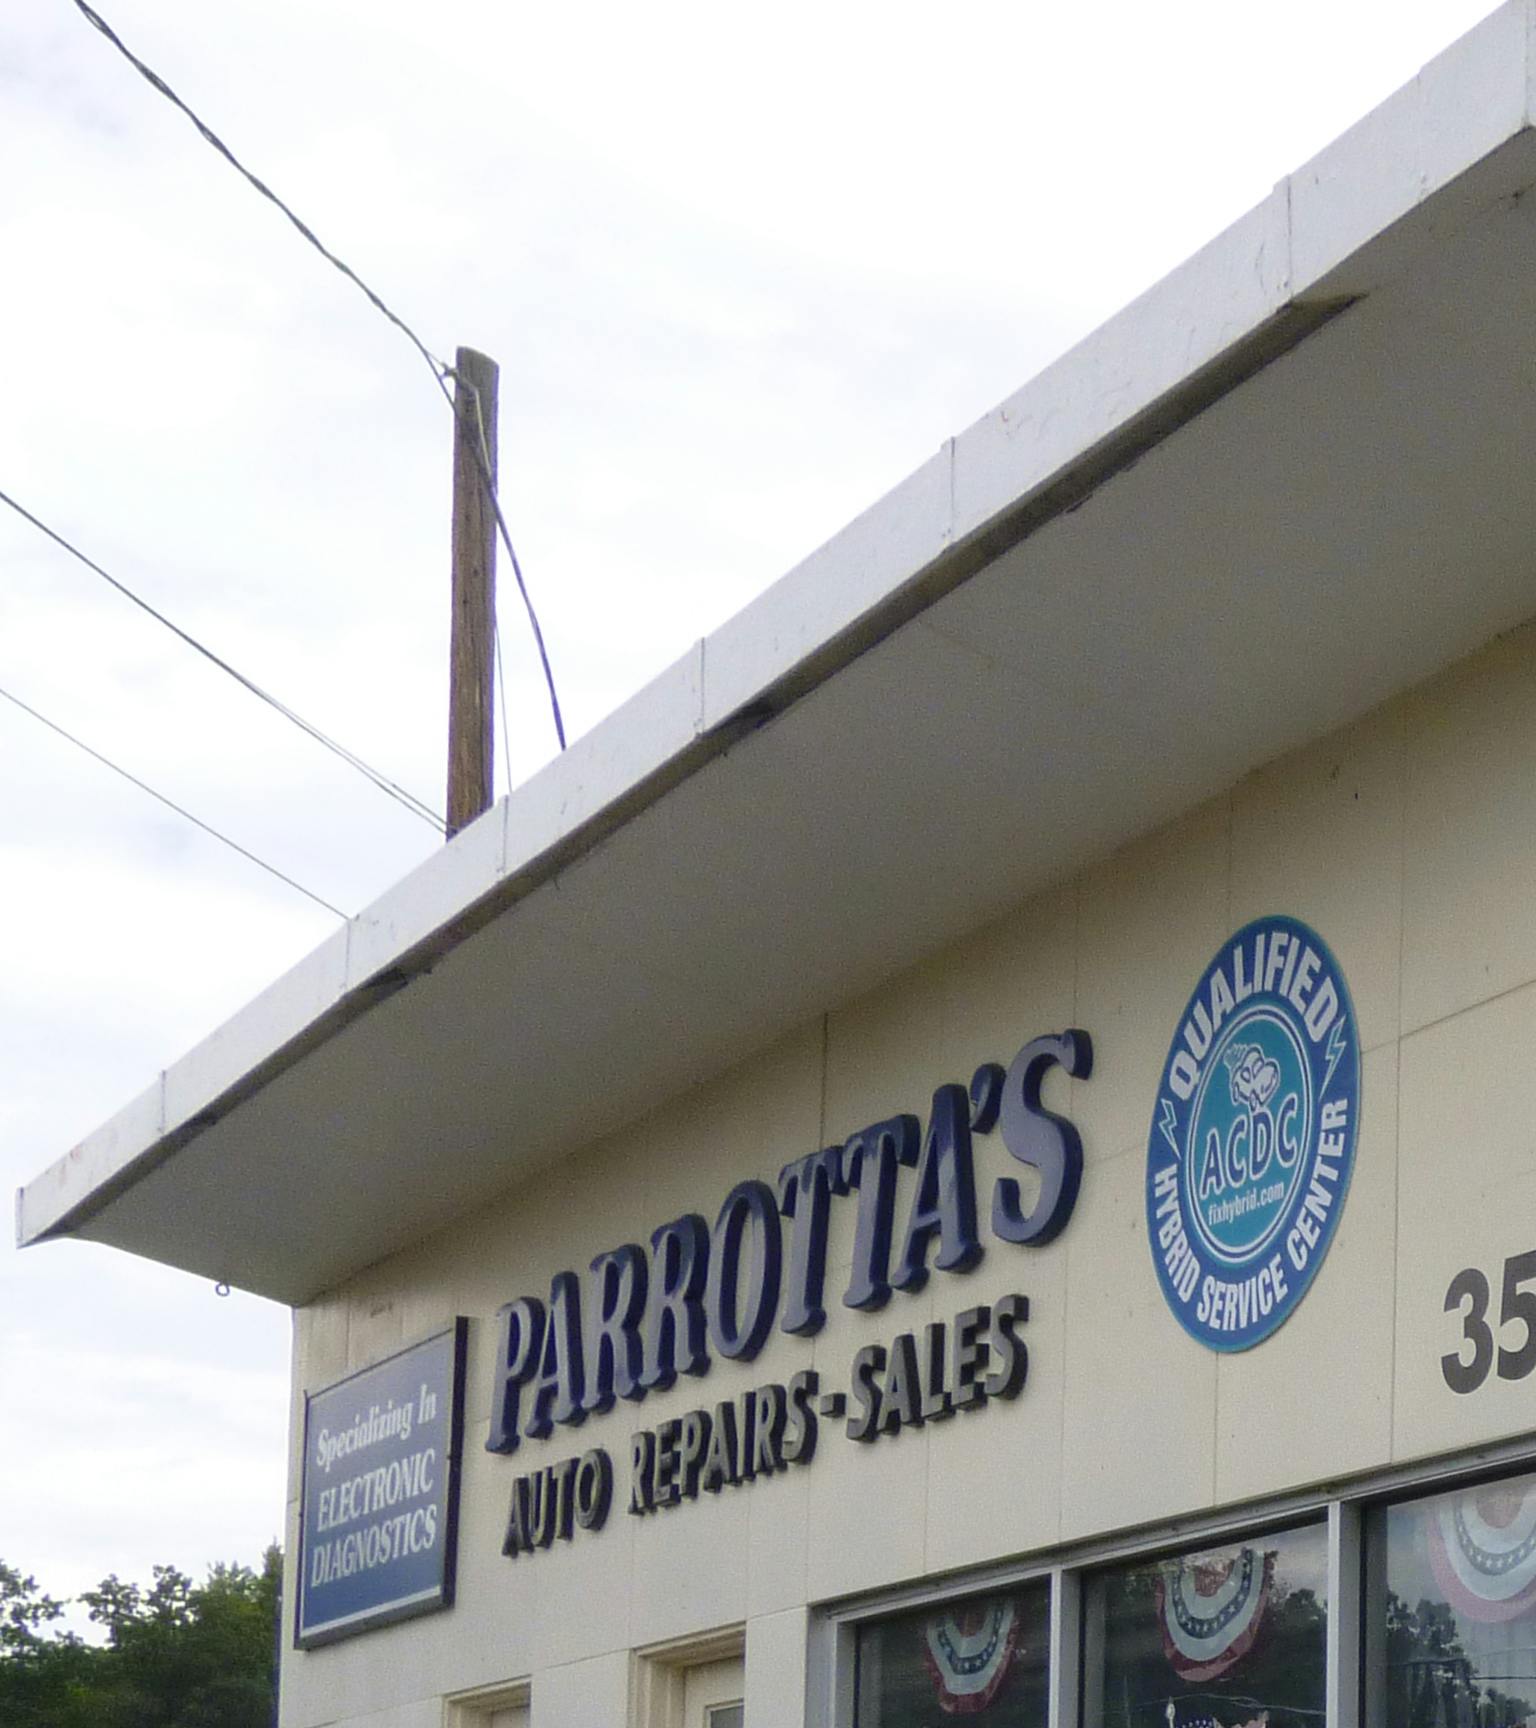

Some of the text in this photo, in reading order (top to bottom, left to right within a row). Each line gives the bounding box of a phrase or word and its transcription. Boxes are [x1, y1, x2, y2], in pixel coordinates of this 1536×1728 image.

[1168, 931, 1340, 1102] QUALIFIED
[1200, 1092, 1299, 1200] ACDC
[485, 1029, 1092, 1455] PARROTTA'S
[1154, 1098, 1349, 1331] HYBRID SERVICE CENTER
[1207, 1181, 1286, 1227] fixhybrid.com
[316, 1383, 437, 1468] Specializing In
[316, 1449, 436, 1532] ELECTRONIC
[501, 1448, 613, 1558] AUTO
[310, 1504, 436, 1588] DIAGNOSTICS
